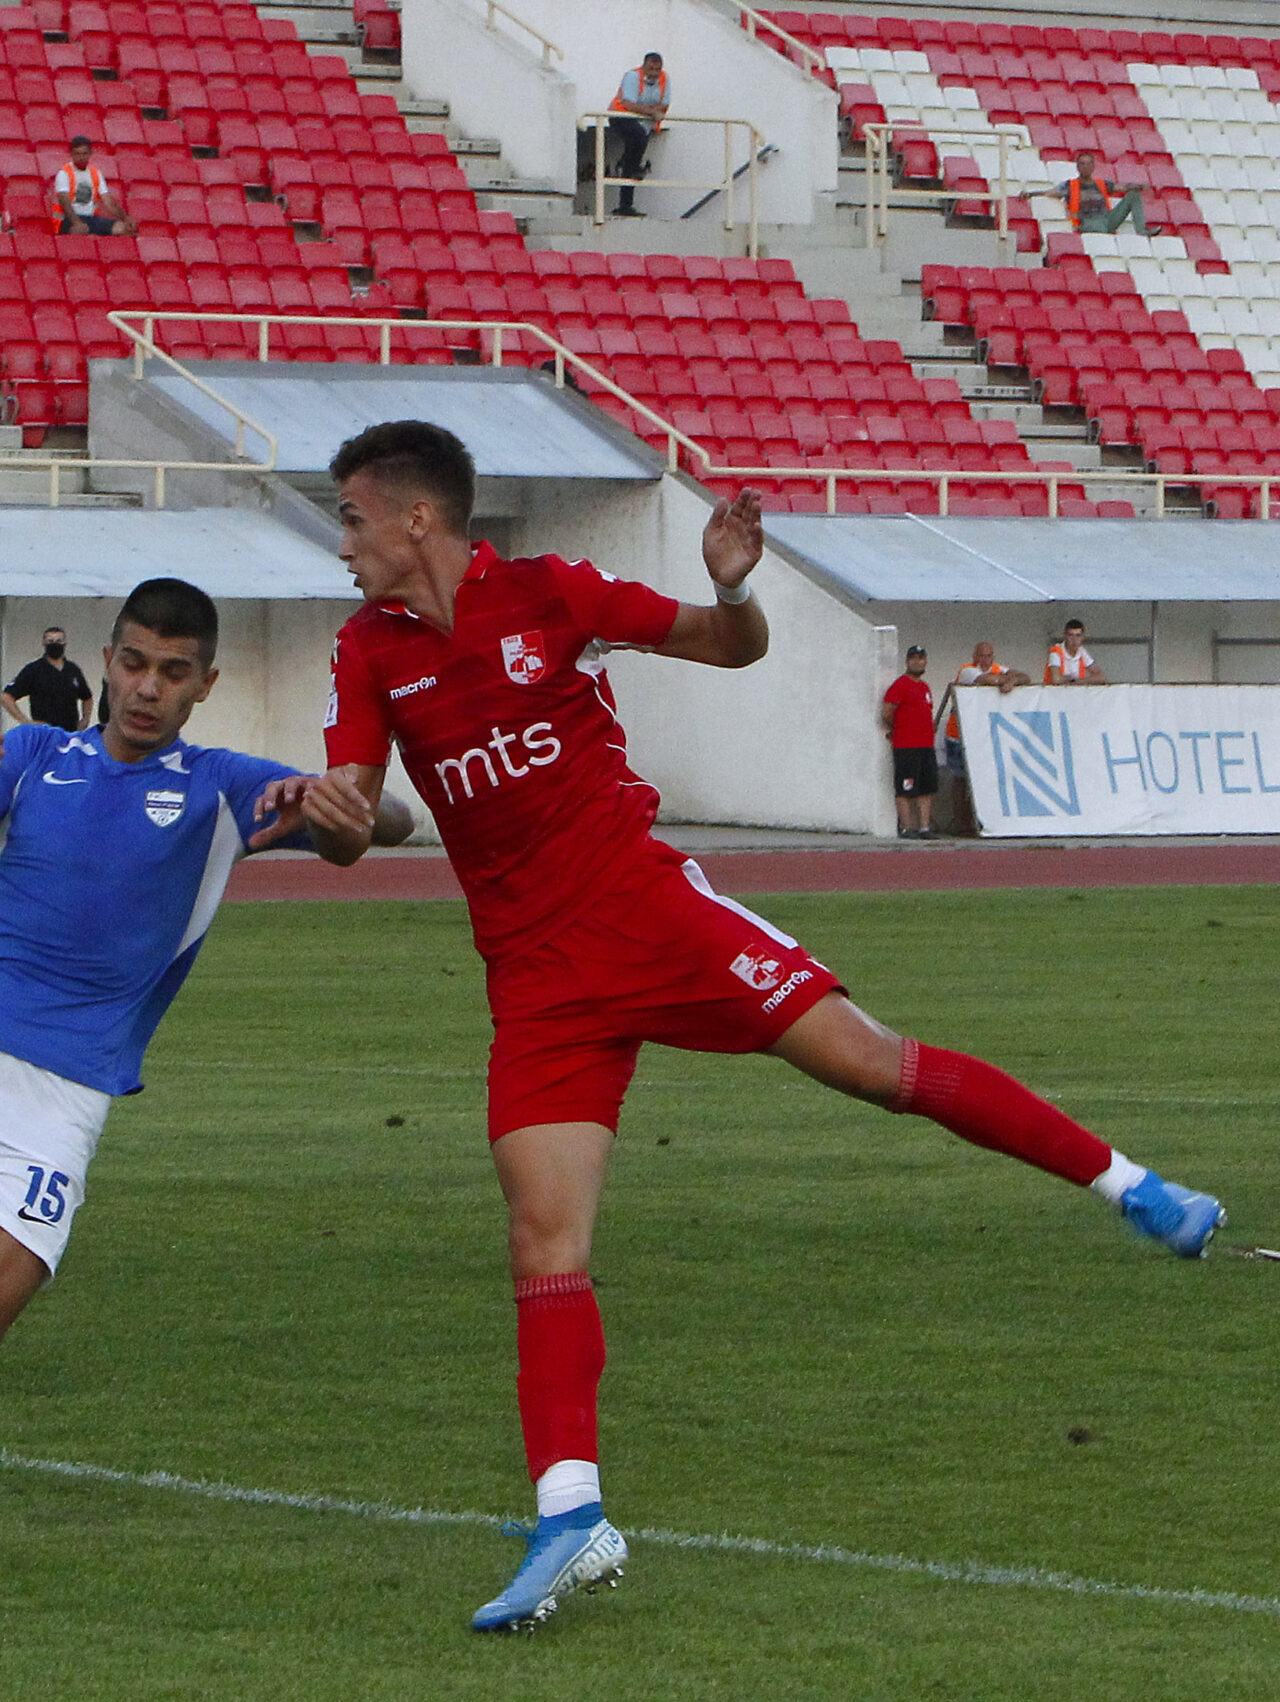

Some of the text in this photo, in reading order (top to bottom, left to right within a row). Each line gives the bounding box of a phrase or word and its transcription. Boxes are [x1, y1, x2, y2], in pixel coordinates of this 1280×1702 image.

[389, 674, 438, 701] macron
[434, 721, 563, 805] mts
[1101, 729, 1280, 794] HOTEL
[760, 968, 814, 1015] macron
[26, 1165, 70, 1223] 15
